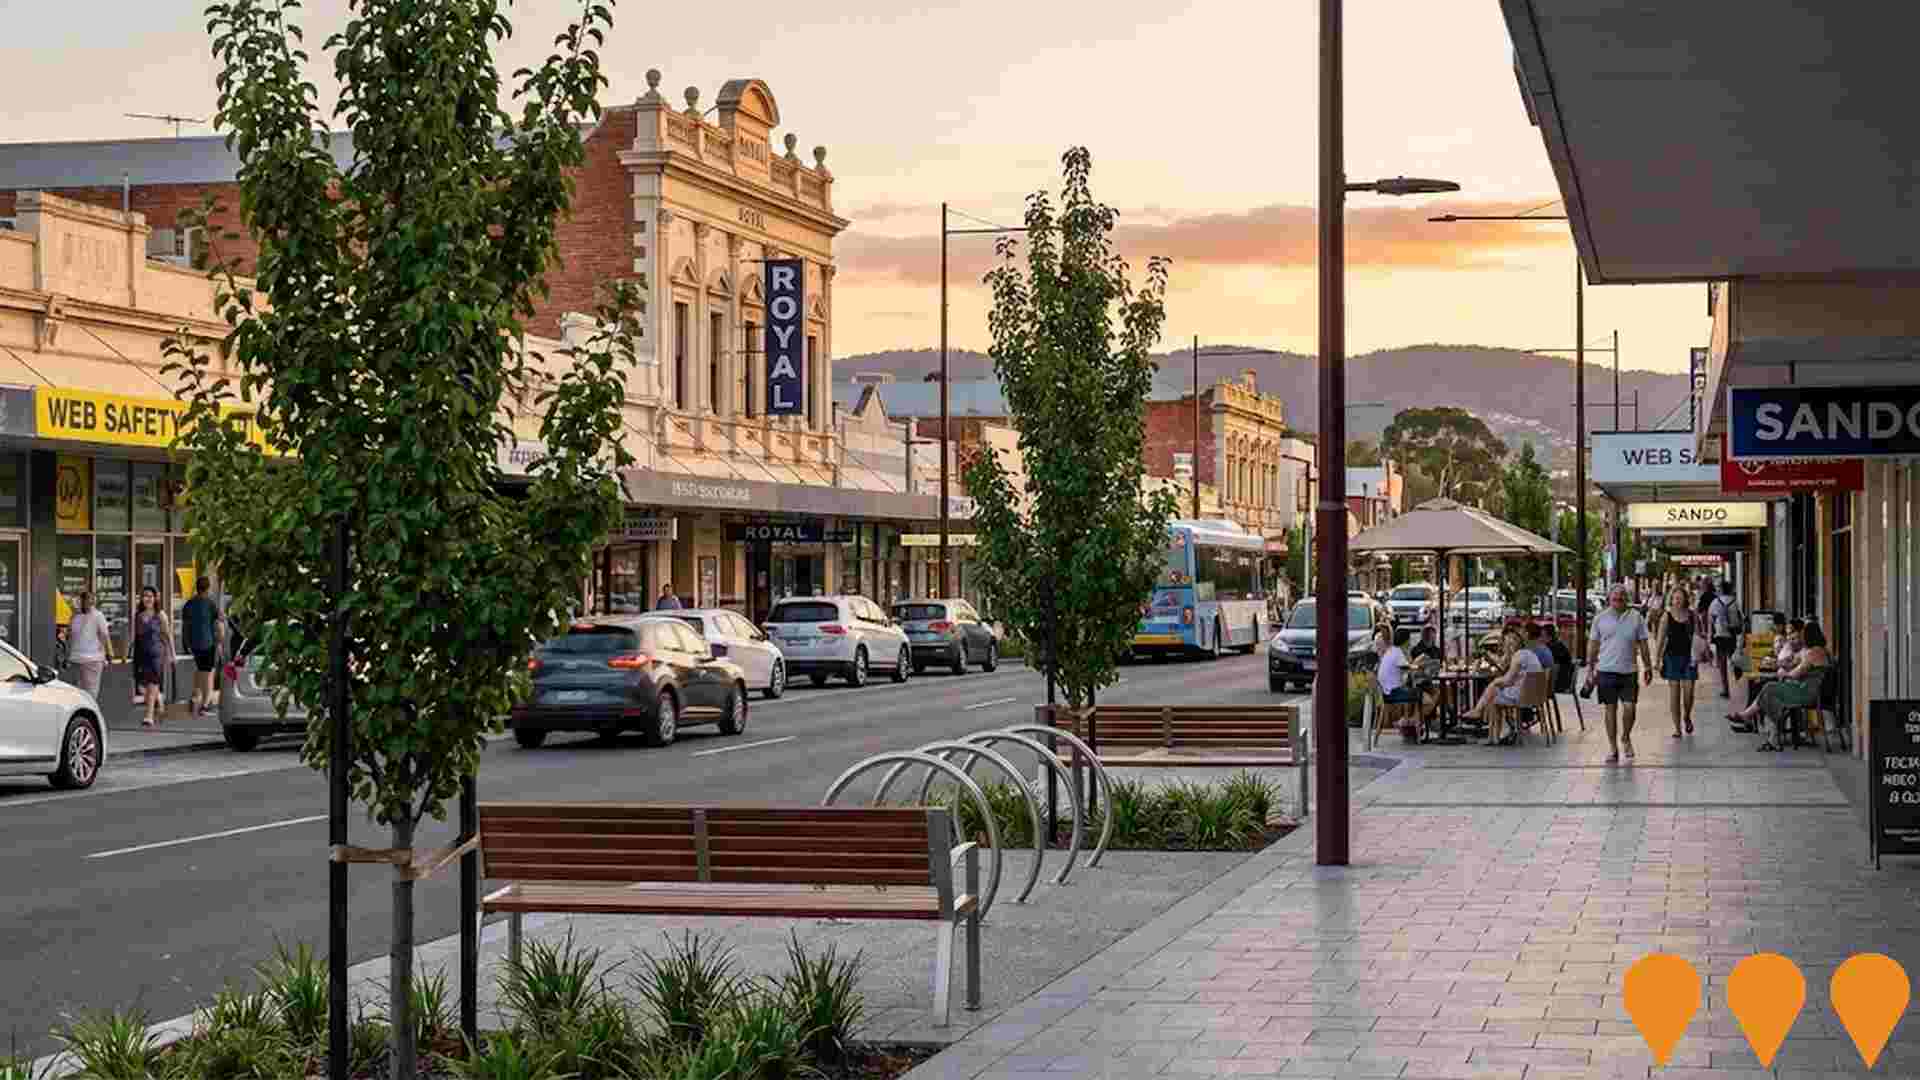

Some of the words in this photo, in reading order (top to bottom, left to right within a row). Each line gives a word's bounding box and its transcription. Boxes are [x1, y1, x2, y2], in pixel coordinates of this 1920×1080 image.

[770, 265, 797, 409] ROYAL
[47, 397, 97, 430] WEB
[104, 403, 183, 437] SAFETY
[1622, 448, 1673, 465] WEB
[1667, 507, 1728, 522] SANDO
[745, 526, 808, 539] ROYAL
